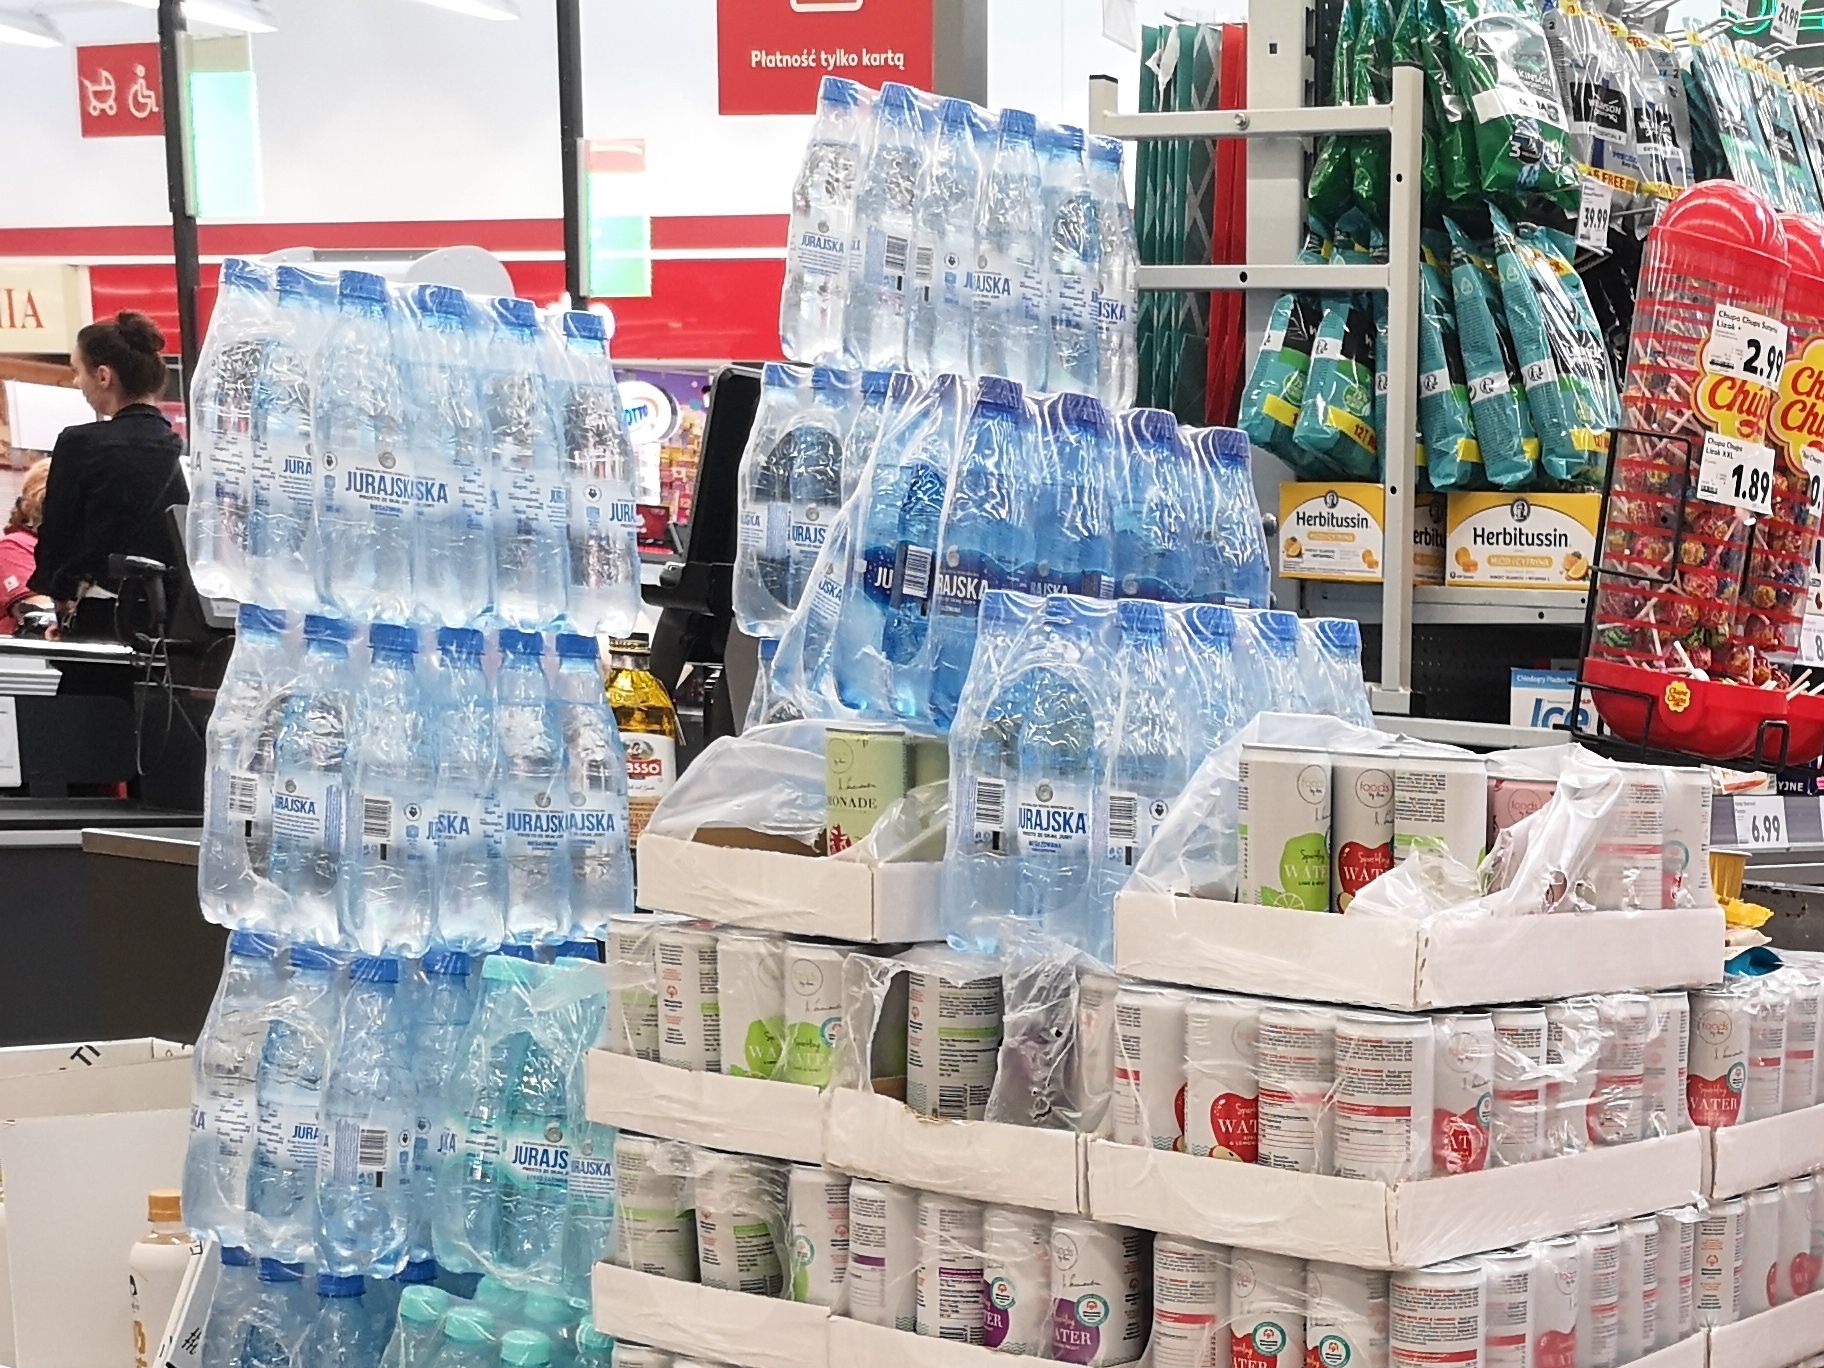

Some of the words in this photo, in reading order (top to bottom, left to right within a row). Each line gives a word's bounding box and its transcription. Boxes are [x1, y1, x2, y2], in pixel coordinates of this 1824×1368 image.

[750, 47, 817, 69] Płatność
[820, 48, 858, 70] tylko
[861, 48, 905, 70] kartą
[0, 288, 44, 329] IA
[1742, 338, 1784, 382] 2.99
[1731, 463, 1770, 505] 1.89
[1296, 511, 1369, 530] Herbitussin
[1472, 526, 1569, 549] Herbitussin
[1529, 697, 1591, 728] Ice
[626, 760, 659, 778] asso
[1017, 806, 1088, 835] JURAJSKA
[1751, 814, 1781, 844] 6.99
[1343, 866, 1387, 882] WAT
[1217, 1118, 1259, 1134] WAT
[1053, 1326, 1093, 1347] ATER
